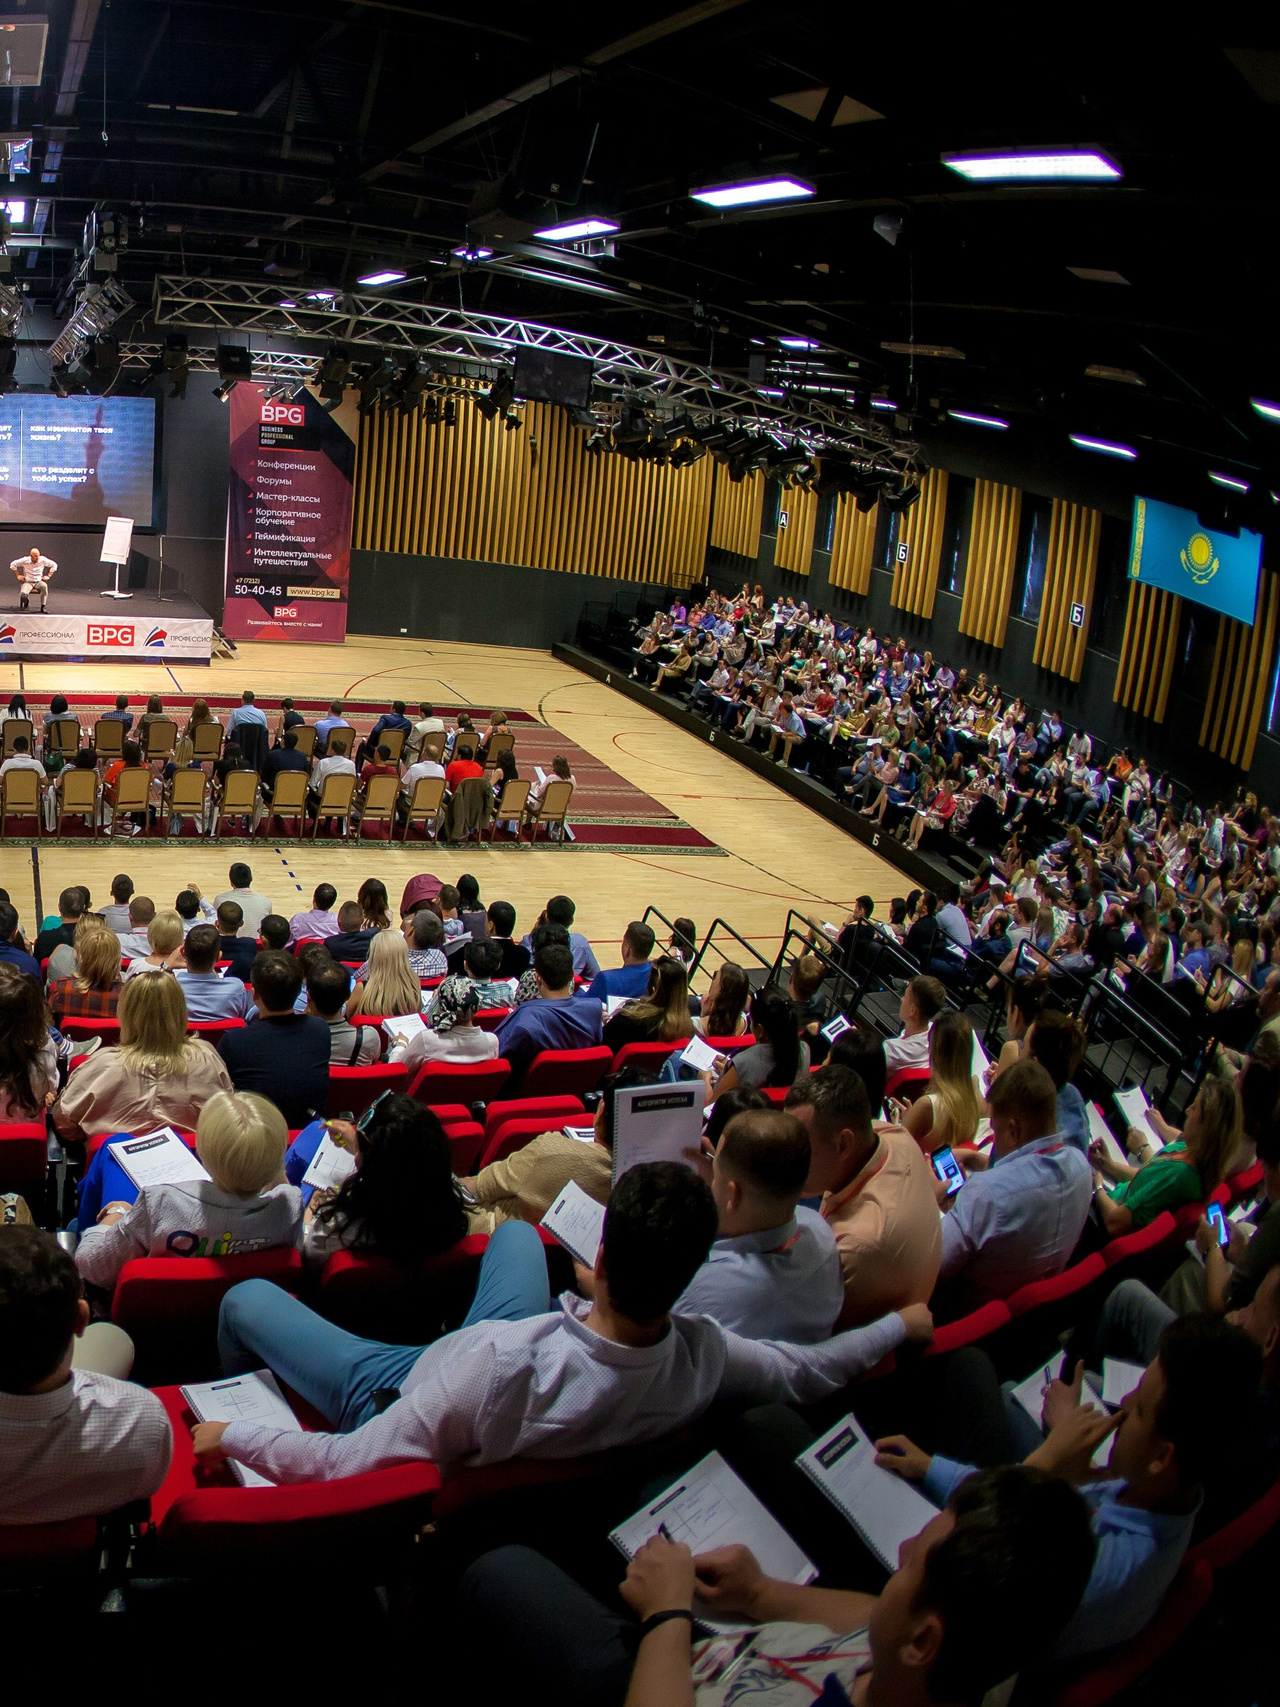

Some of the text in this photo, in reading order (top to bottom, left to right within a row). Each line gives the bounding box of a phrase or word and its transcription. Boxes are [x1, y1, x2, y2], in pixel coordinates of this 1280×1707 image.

[261, 405, 302, 424] BPG
[261, 425, 283, 433] BUSINESS
[257, 460, 316, 471] Конференции
[256, 475, 292, 486] Форумы
[256, 492, 321, 503] Мастер-классы
[255, 508, 322, 519] Корпоративное
[255, 517, 296, 526] обучение
[254, 532, 316, 543] Геймификация
[254, 548, 332, 560] Интеллектуальные
[253, 557, 309, 567] путешествия
[234, 585, 282, 596] 50-40-45
[290, 588, 335, 598] www.bpg.kz
[274, 607, 297, 618] BPG
[19, 631, 75, 639] ПРОФЕССИОНАЛ
[89, 627, 133, 645] BPG
[709, 731, 715, 741] Б
[872, 834, 880, 846] Б
